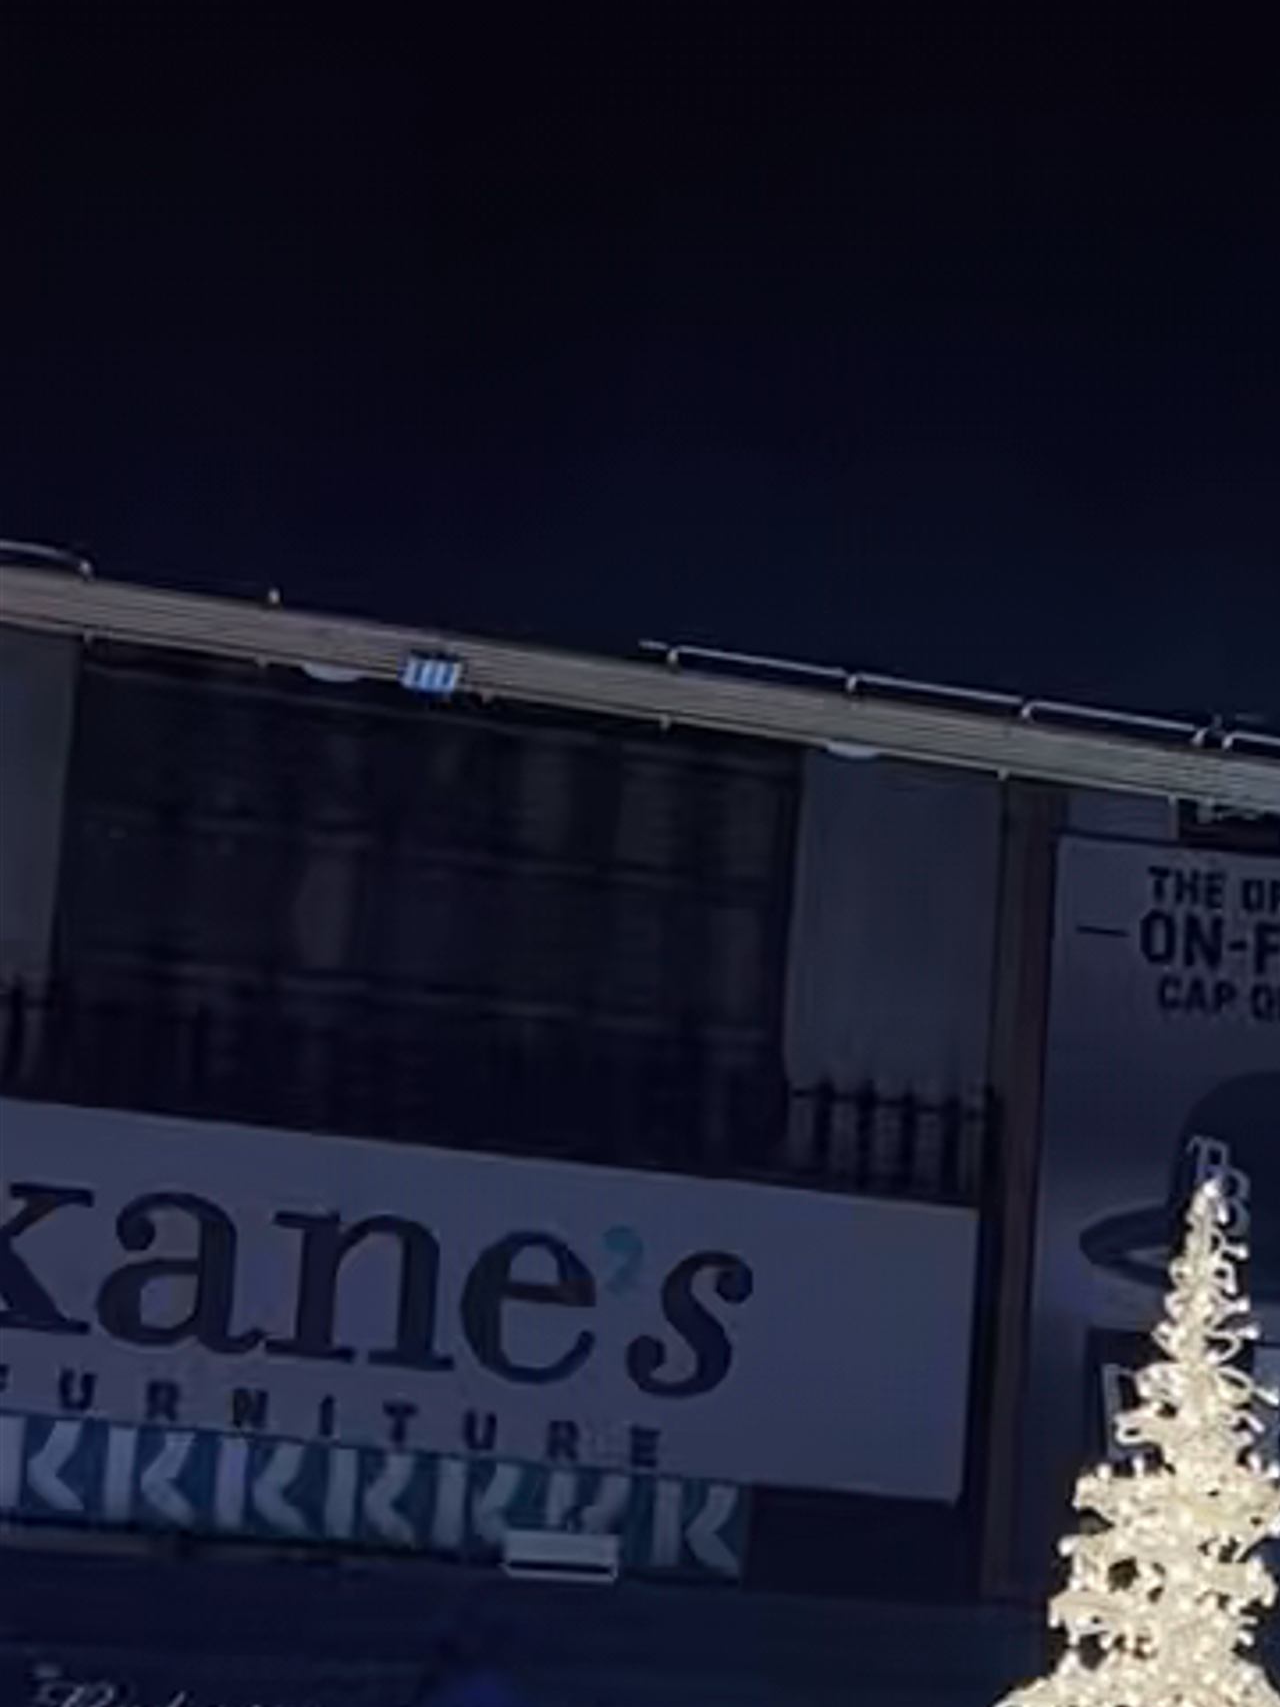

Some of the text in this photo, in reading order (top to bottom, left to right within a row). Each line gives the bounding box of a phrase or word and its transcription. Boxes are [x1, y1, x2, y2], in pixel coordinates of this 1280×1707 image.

[1148, 866, 1224, 909] THE
[1160, 976, 1237, 1014] CAP
[0, 1363, 662, 1469] URNITURE
